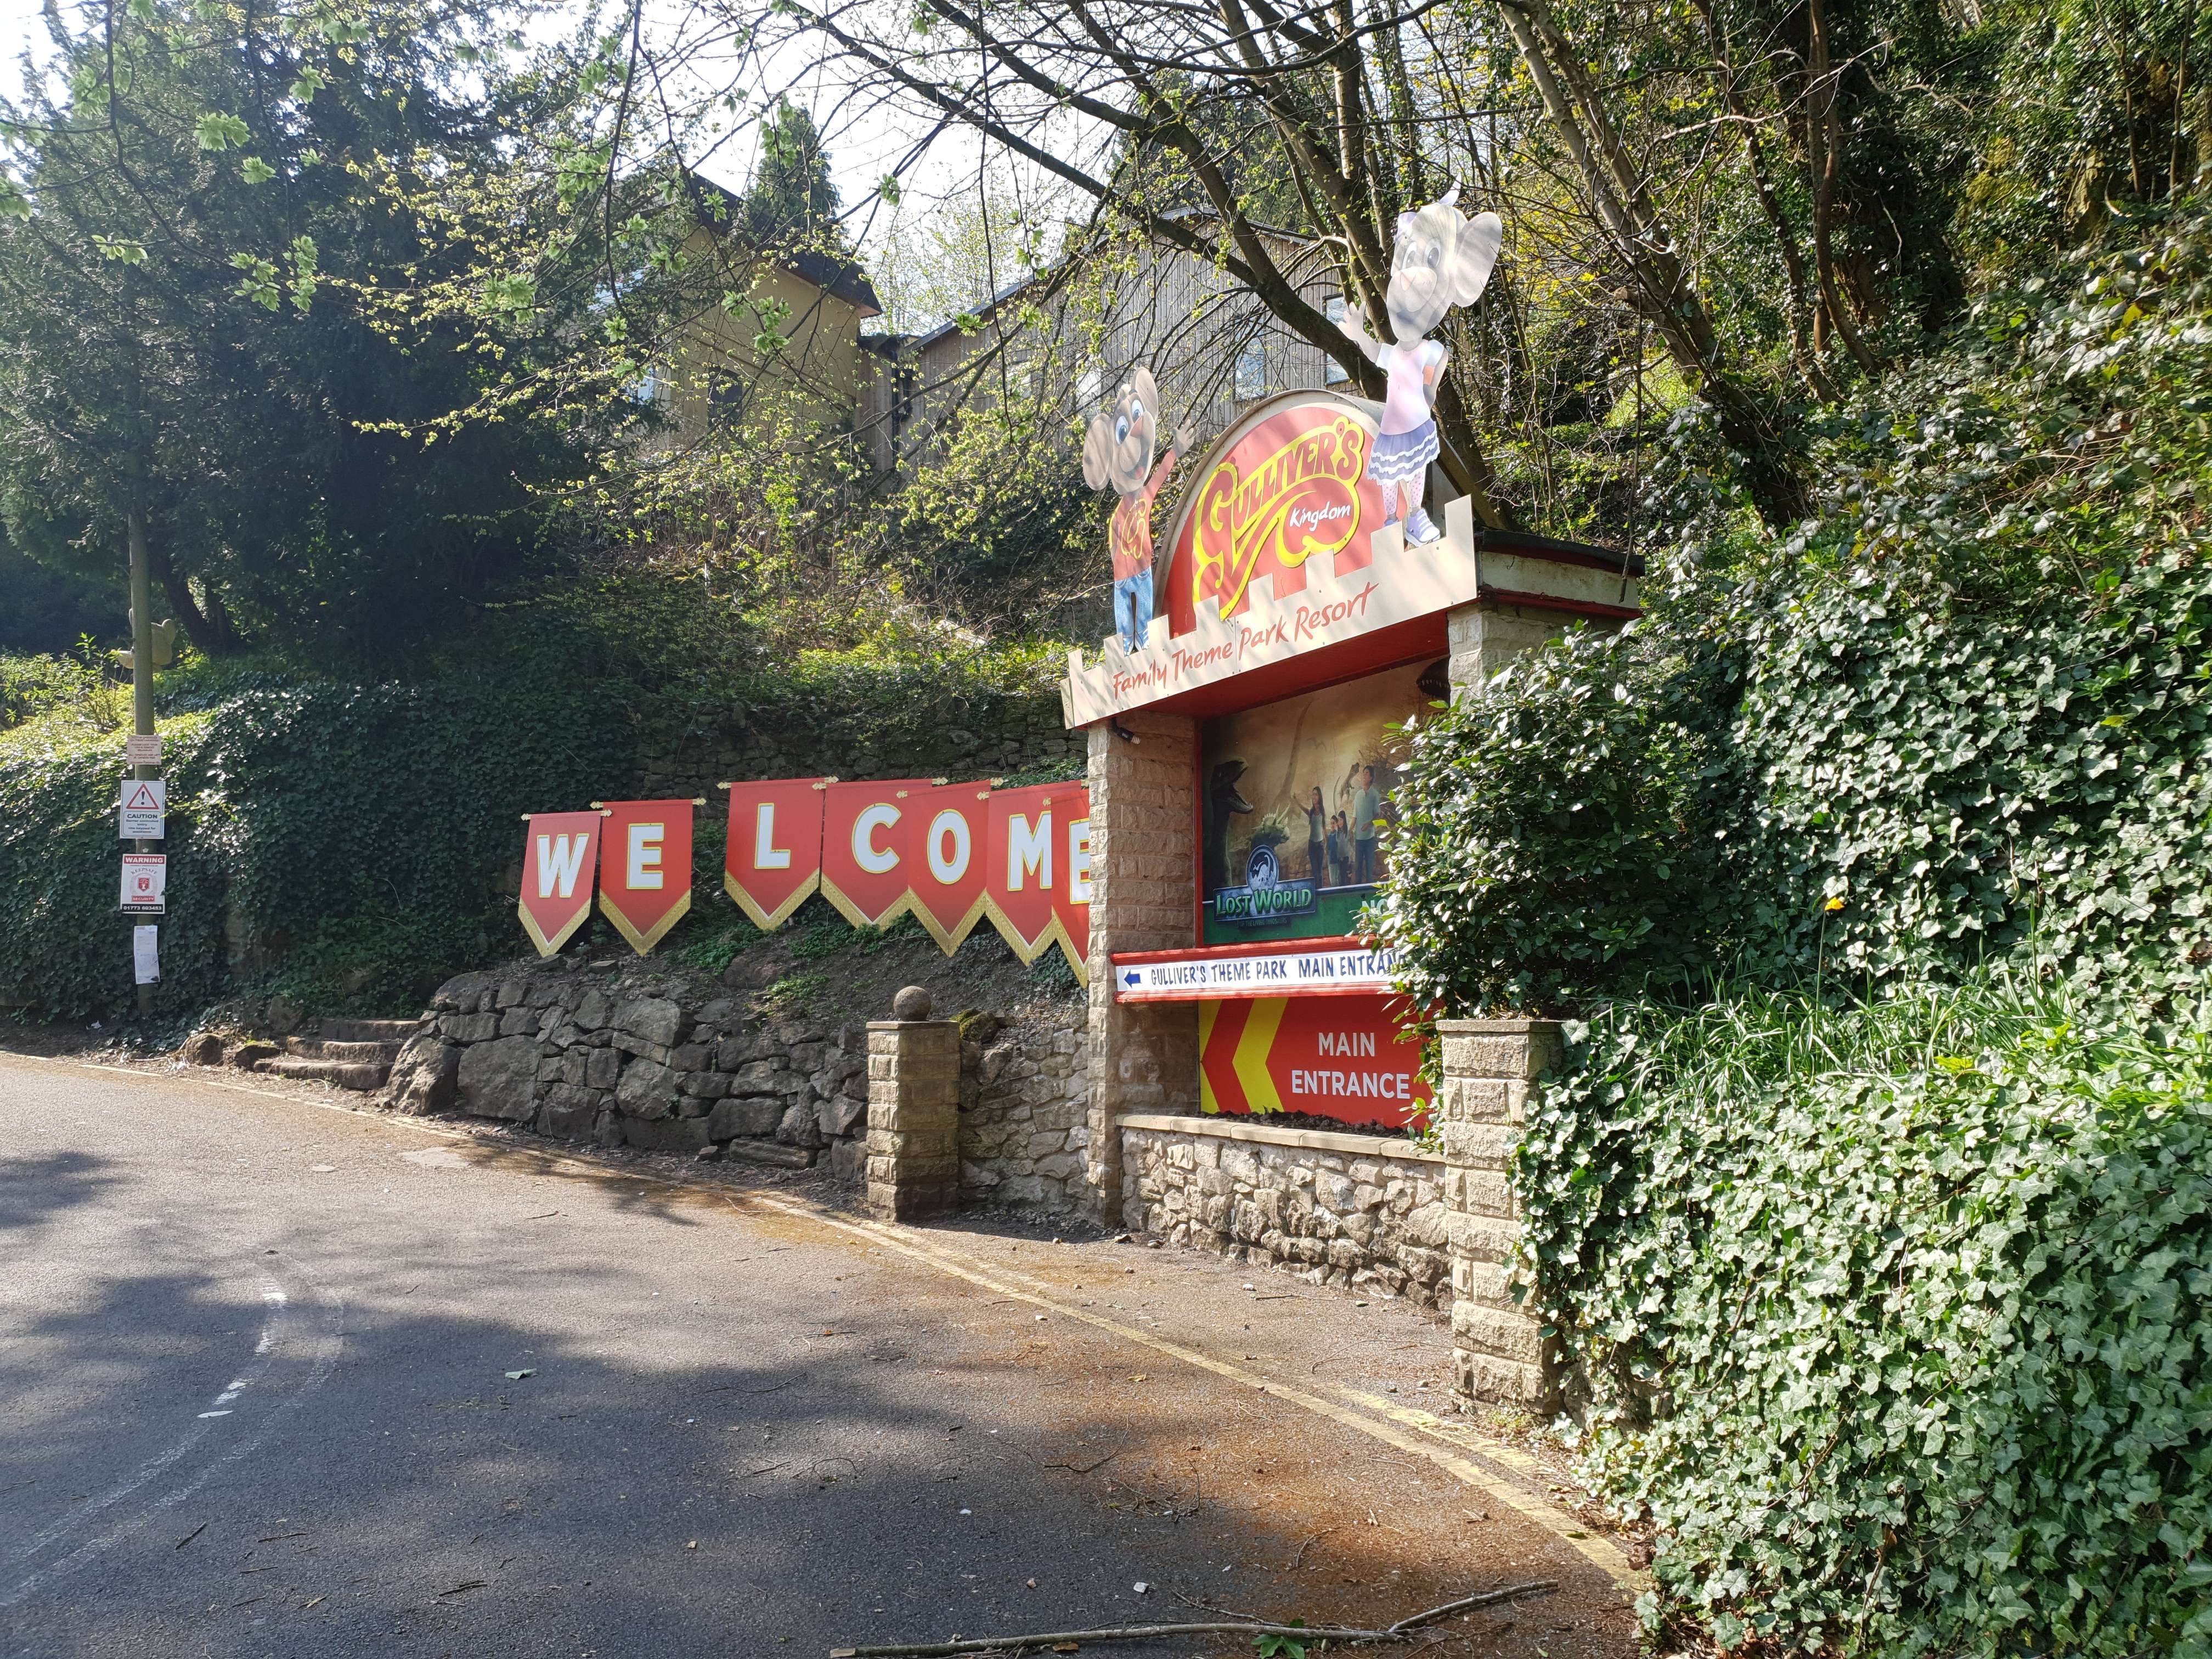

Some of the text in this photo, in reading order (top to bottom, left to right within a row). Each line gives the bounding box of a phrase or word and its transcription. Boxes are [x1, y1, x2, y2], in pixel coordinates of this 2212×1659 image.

[1194, 416, 1364, 617] GULLIVER'S
[1289, 501, 1351, 531] Kingdom
[1113, 582, 1379, 700] Family Theme Park Resort
[1216, 889, 1312, 916] LOST WORLD
[1151, 953, 1405, 985] GULLIVER'S THEME PARK MAIN ENTRA
[1318, 1032, 1375, 1057] MAIN
[1291, 1069, 1410, 1099] ENTRANCE
